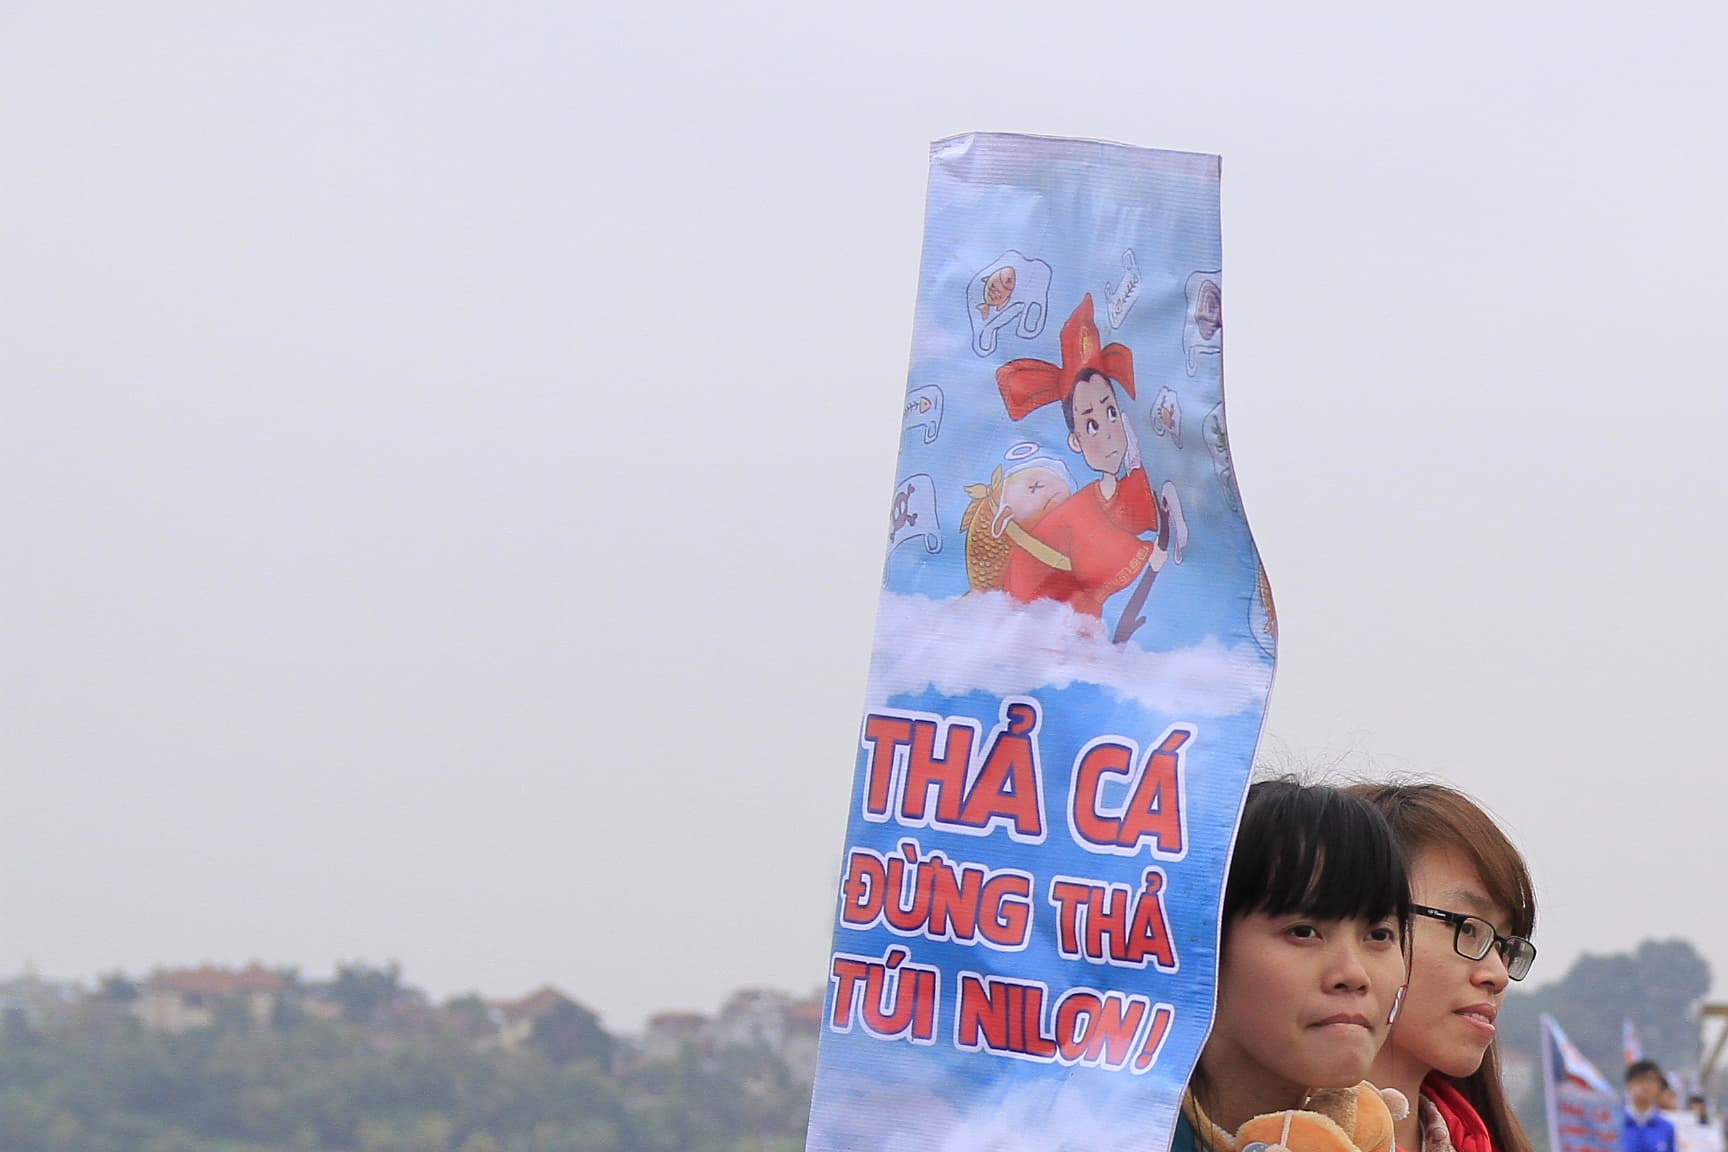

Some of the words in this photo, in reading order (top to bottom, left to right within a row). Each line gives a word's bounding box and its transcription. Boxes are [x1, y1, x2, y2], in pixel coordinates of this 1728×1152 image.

[865, 702, 1042, 836] THẢ
[1073, 729, 1191, 853] CÁ
[843, 842, 1030, 946] ĐỪNG
[1050, 871, 1175, 968] THẢ
[832, 950, 936, 1040] TÚI
